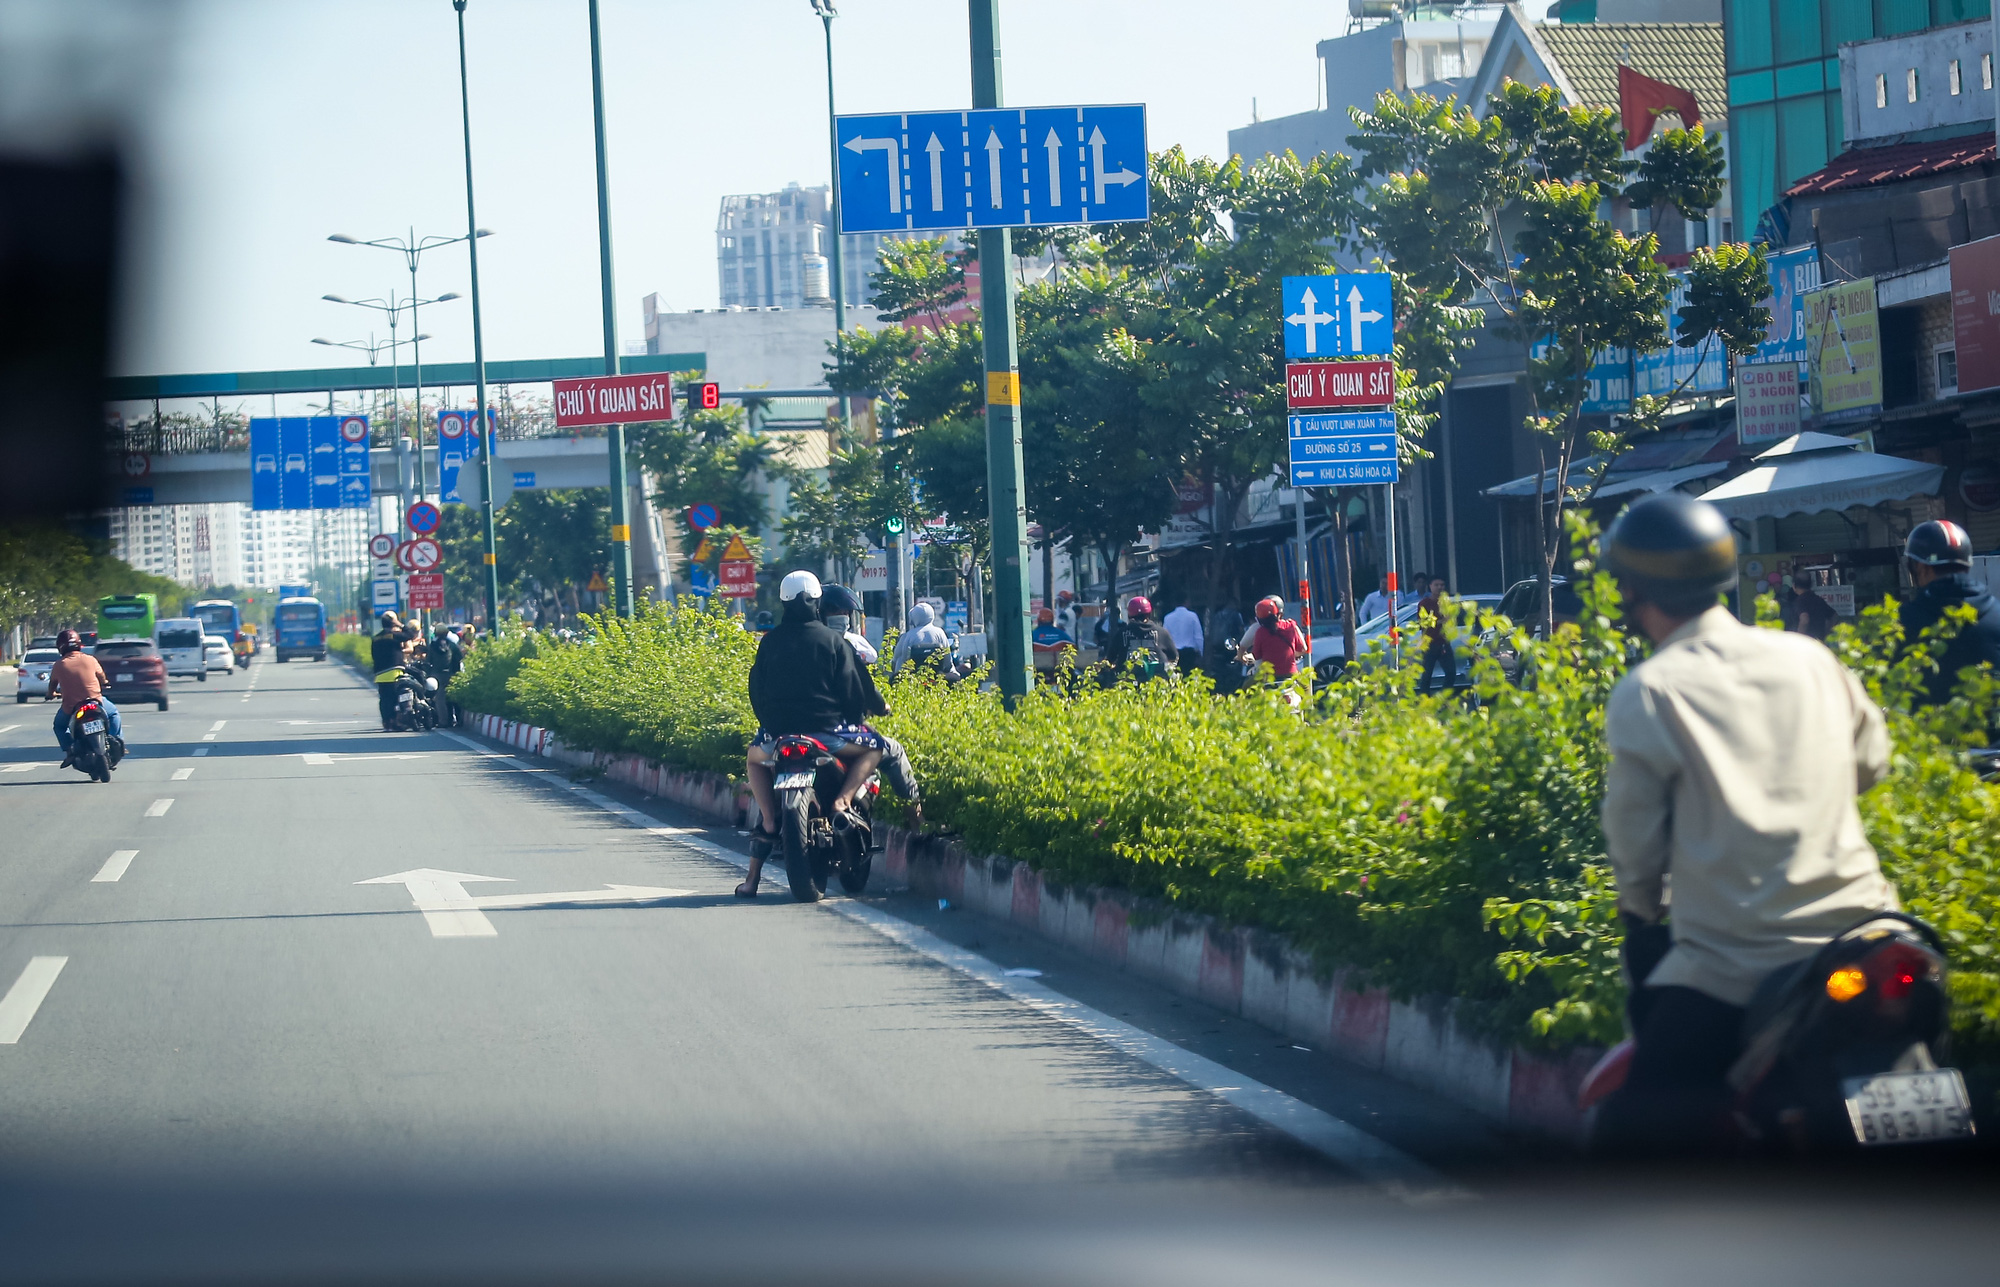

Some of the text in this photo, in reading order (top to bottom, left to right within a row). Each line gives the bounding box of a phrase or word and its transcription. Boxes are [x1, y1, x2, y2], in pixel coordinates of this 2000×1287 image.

[1848, 289, 1872, 316] NGON
[1291, 367, 1390, 398] CHÚ Ý QUAN SÁT
[1757, 368, 1794, 384] BÒ NÉ
[703, 383, 718, 409] 8
[1002, 384, 1008, 395] 4
[1749, 385, 1795, 398] 3 NGON
[557, 379, 665, 416] CHÚ Ý QUAN SÁT
[349, 424, 359, 434] 50
[447, 422, 457, 431] 50
[1306, 418, 1319, 431] CẦU
[1340, 420, 1356, 430] LINH
[1357, 417, 1375, 429] XUÂN
[1305, 439, 1361, 454] ĐƯỜNG SỐ 25
[1320, 468, 1335, 480] KHU
[1350, 463, 1364, 478] SẤU
[1365, 466, 1379, 478] HOA
